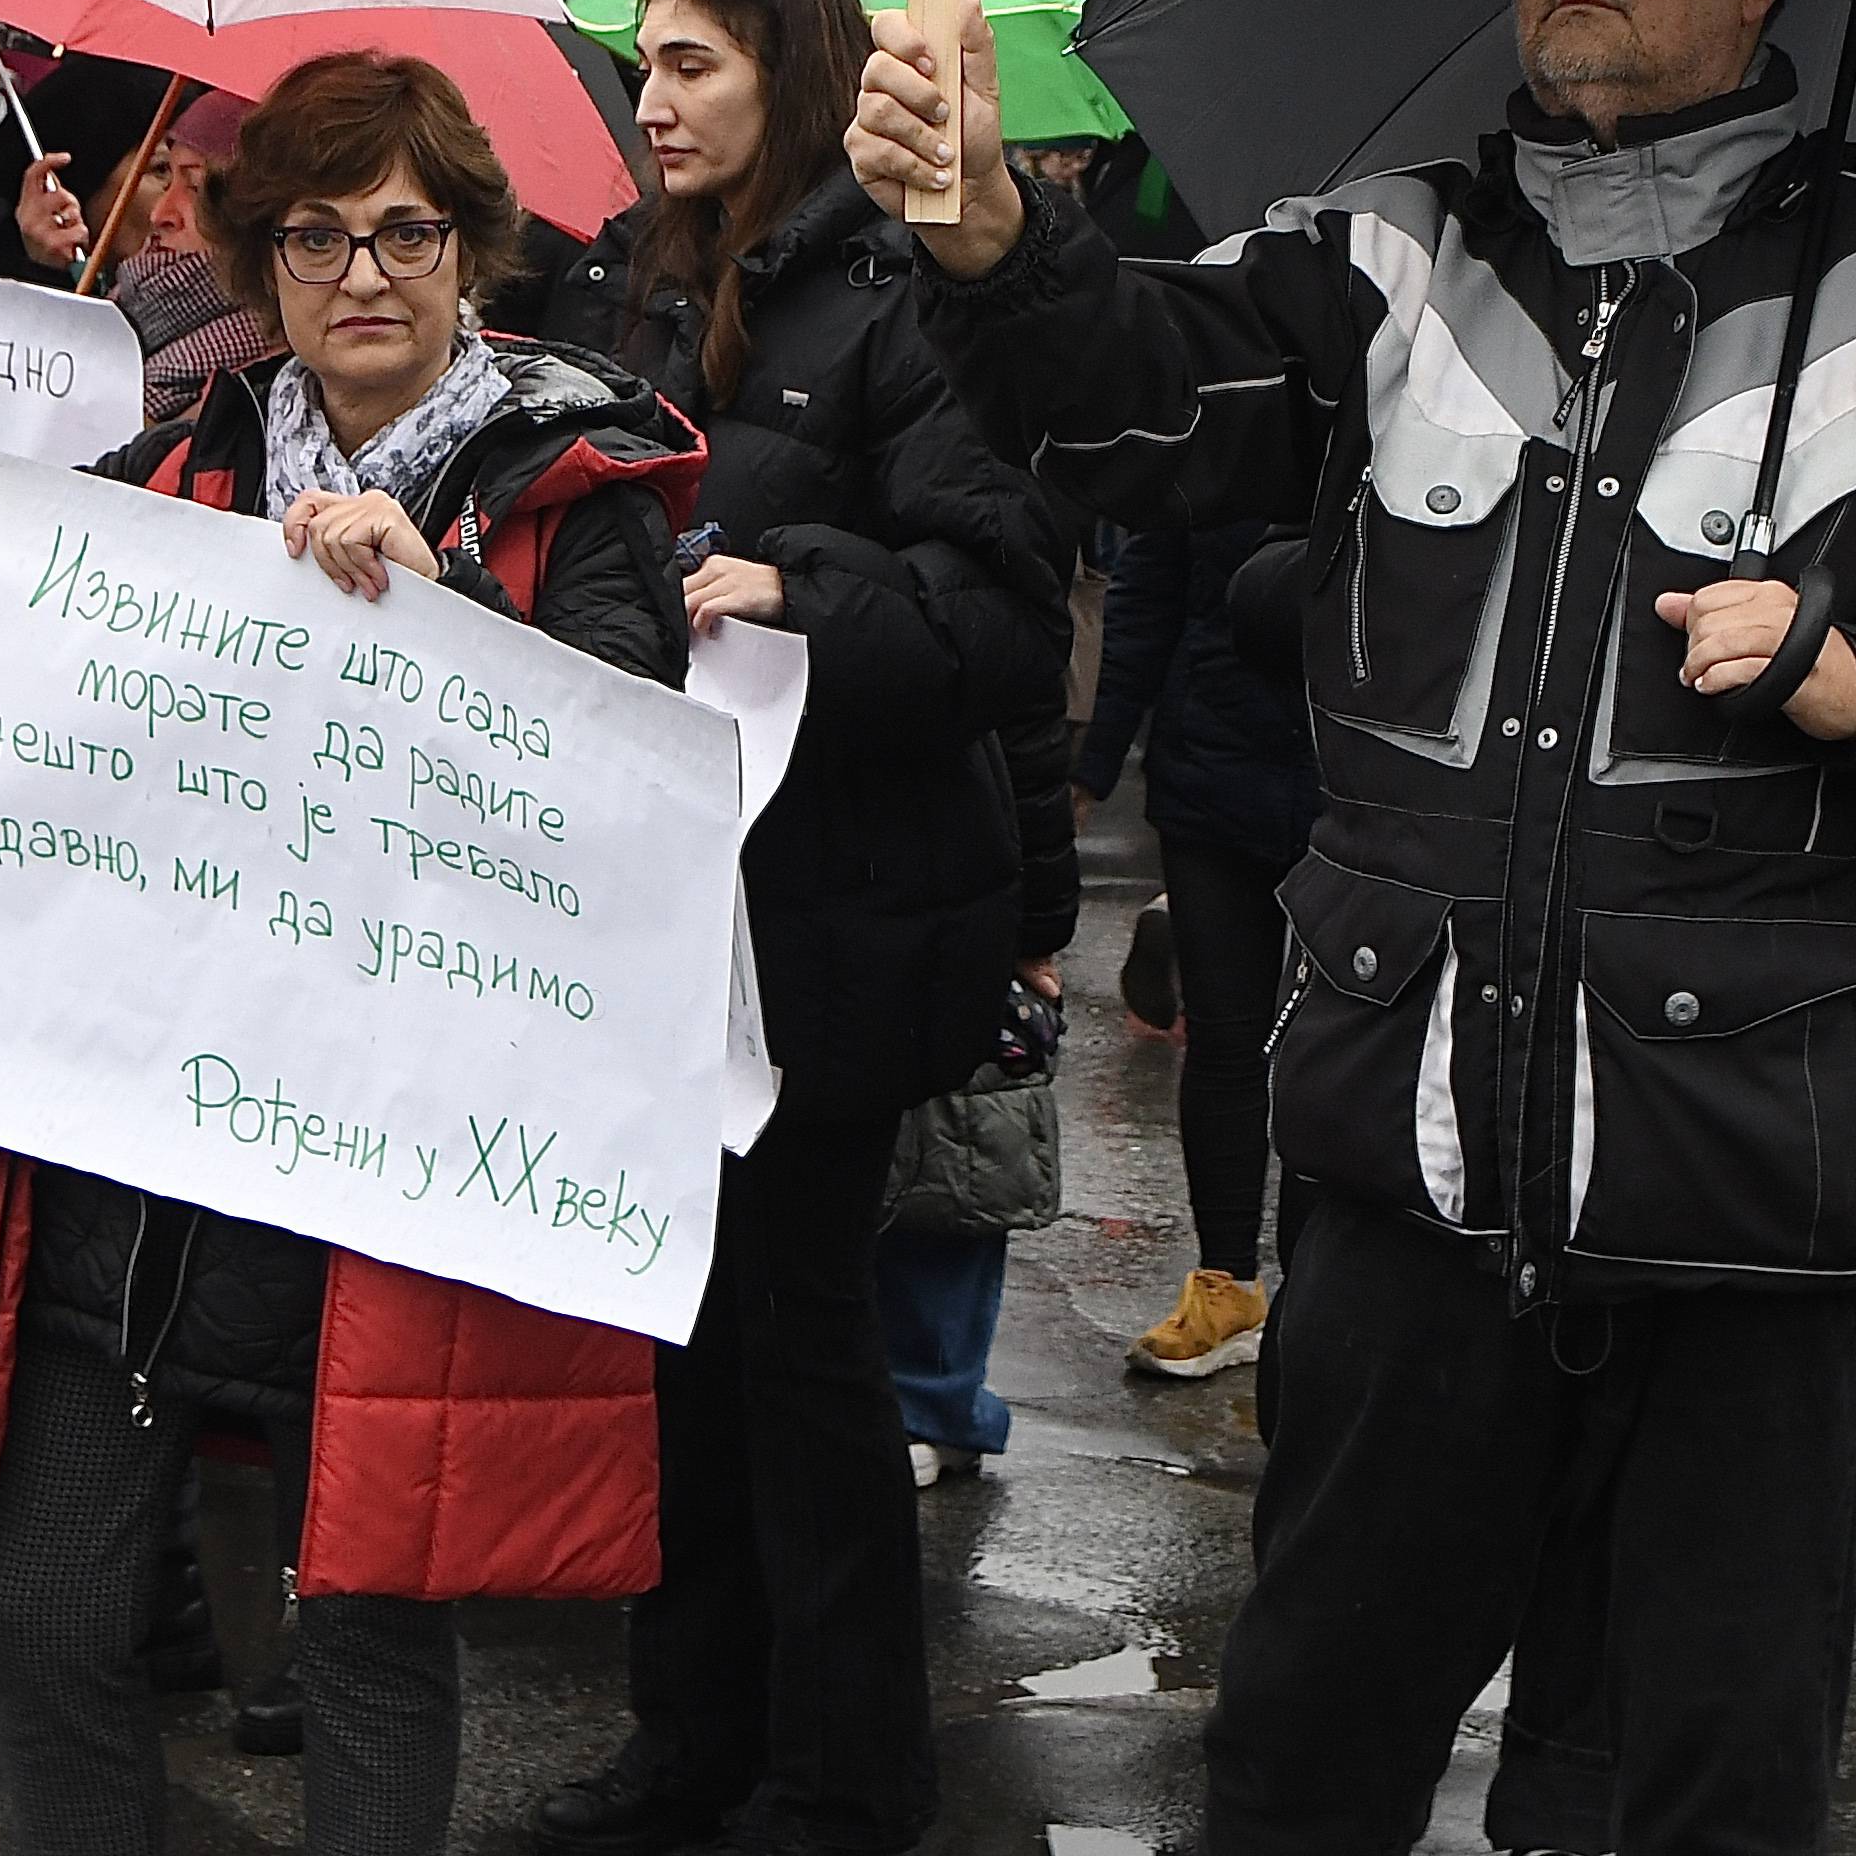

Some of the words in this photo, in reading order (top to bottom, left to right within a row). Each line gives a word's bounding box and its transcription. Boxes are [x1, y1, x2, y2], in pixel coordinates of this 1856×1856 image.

[28, 524, 314, 670] Извините
[340, 641, 424, 704] што
[78, 659, 271, 740] морате
[313, 721, 386, 776] да
[410, 746, 564, 842] радите
[176, 760, 268, 812] што
[287, 782, 336, 862] је
[370, 808, 580, 917] требало
[174, 857, 239, 910] ми
[268, 888, 334, 943] да
[357, 918, 593, 1021] урадимо
[181, 1054, 386, 1177] Рођени
[402, 1145, 436, 1200] у
[551, 1170, 670, 1275] веку
